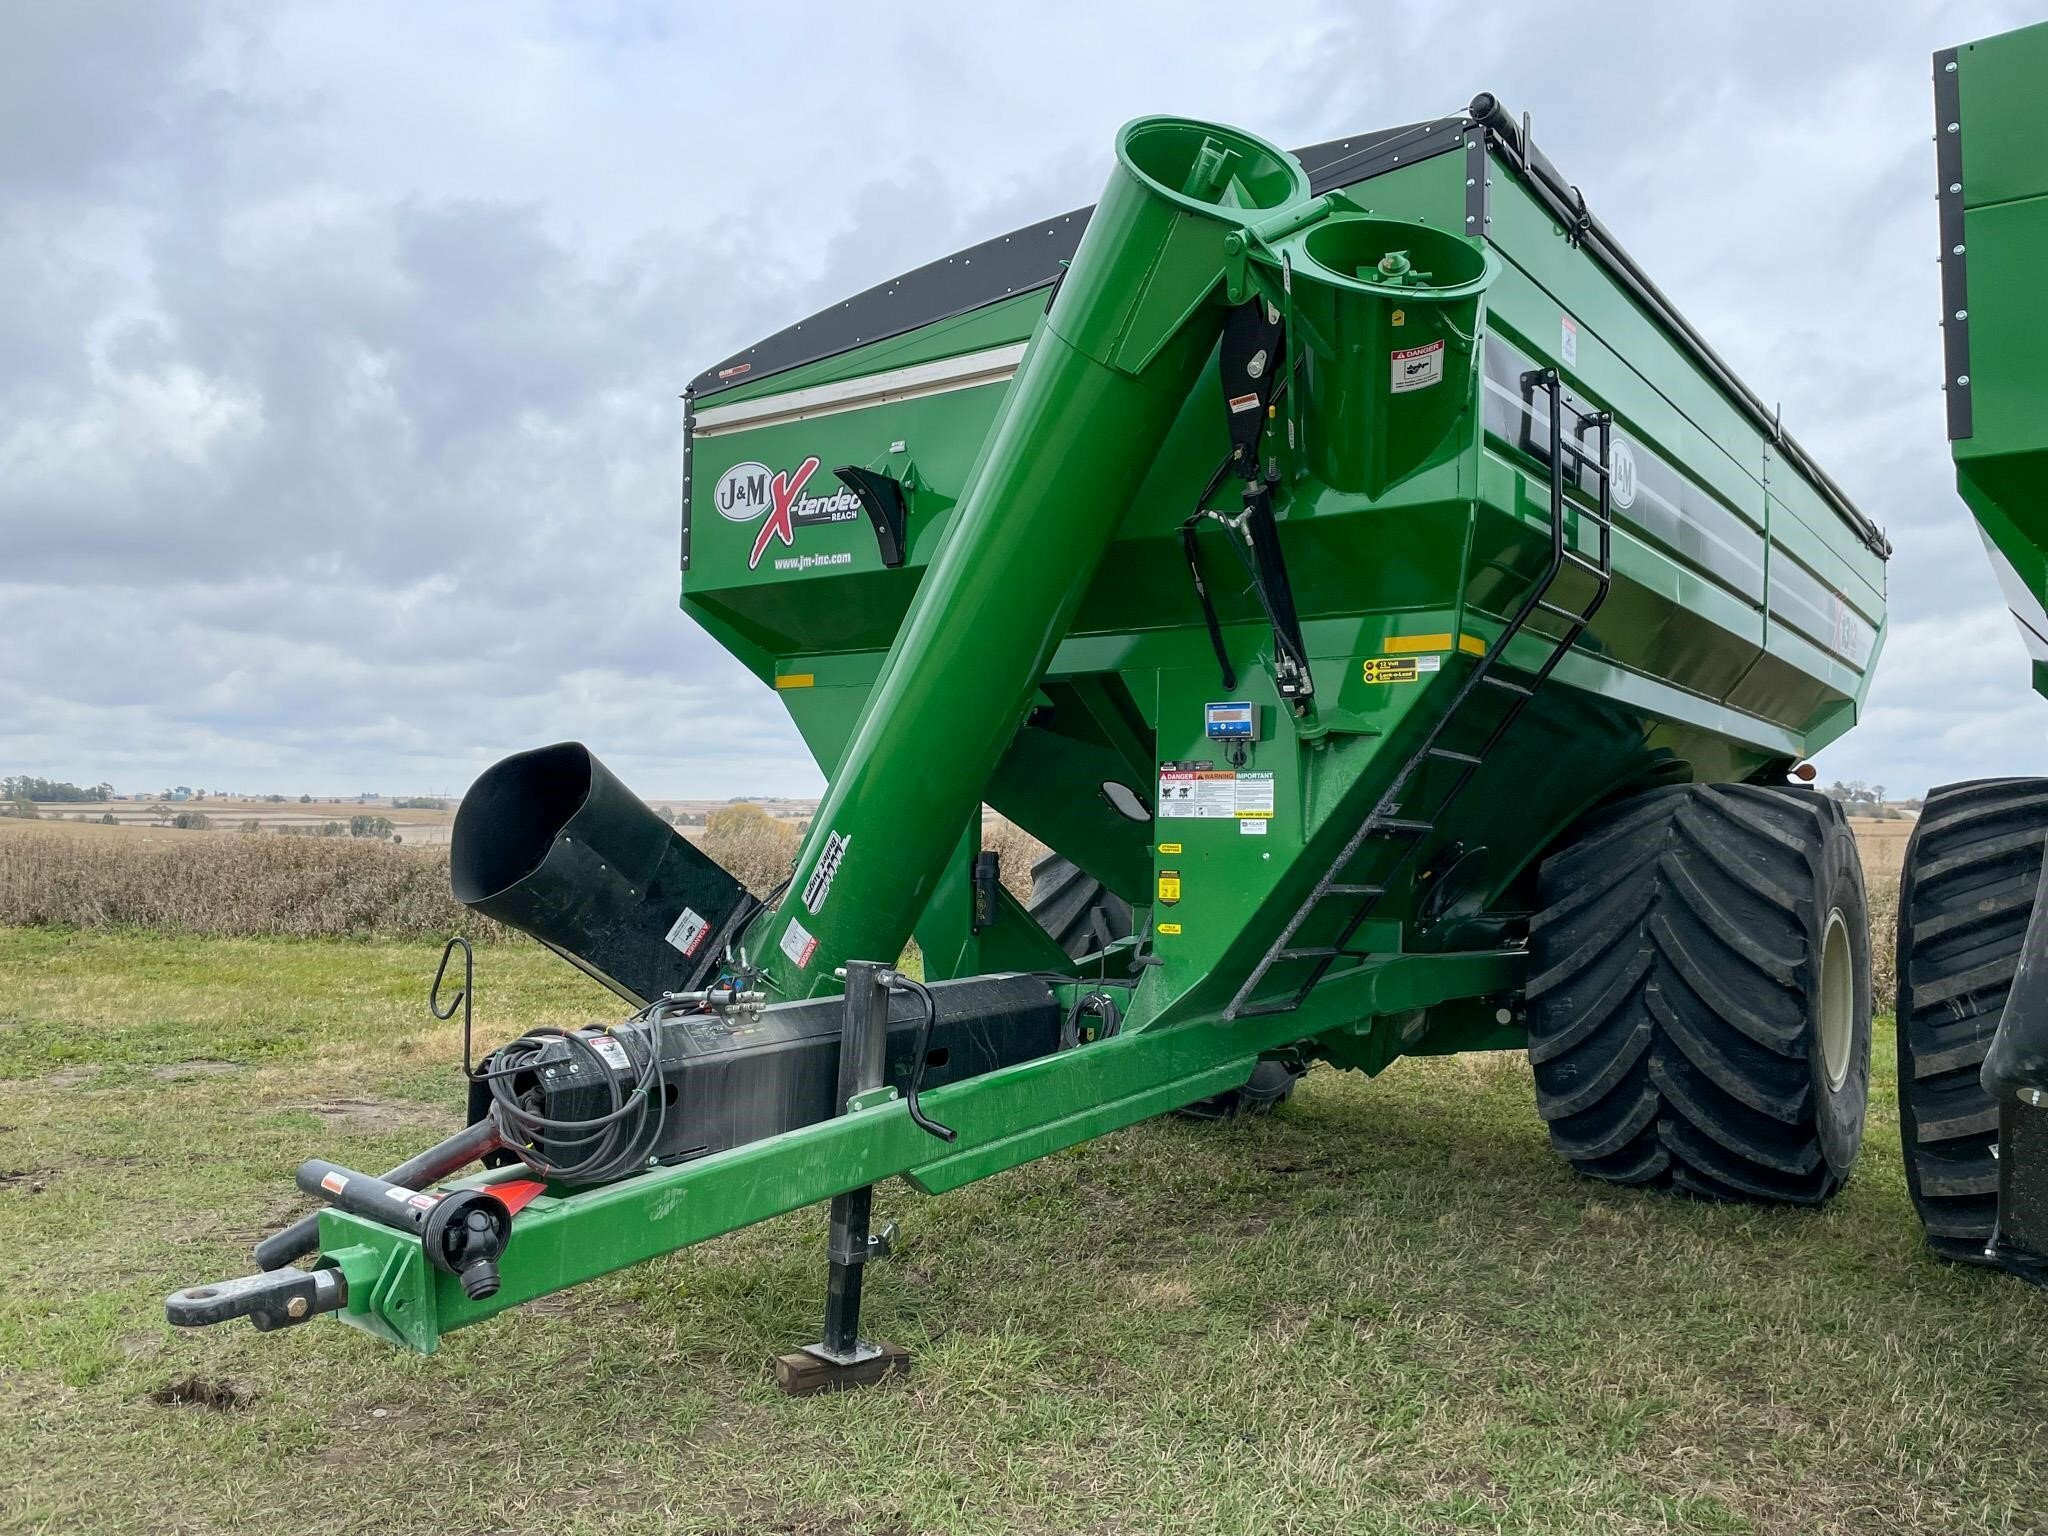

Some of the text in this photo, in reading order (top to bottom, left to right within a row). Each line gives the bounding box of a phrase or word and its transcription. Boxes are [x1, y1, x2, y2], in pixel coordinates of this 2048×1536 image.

[1406, 343, 1439, 357] DANGER
[1611, 452, 1633, 497] J&M
[721, 475, 767, 510] J&M
[831, 511, 857, 522] REACH
[775, 552, 851, 570] www.jm-inc.com
[805, 836, 838, 902] Bullet Auger
[686, 930, 706, 956] DANGER
[799, 942, 815, 967] DANGER
